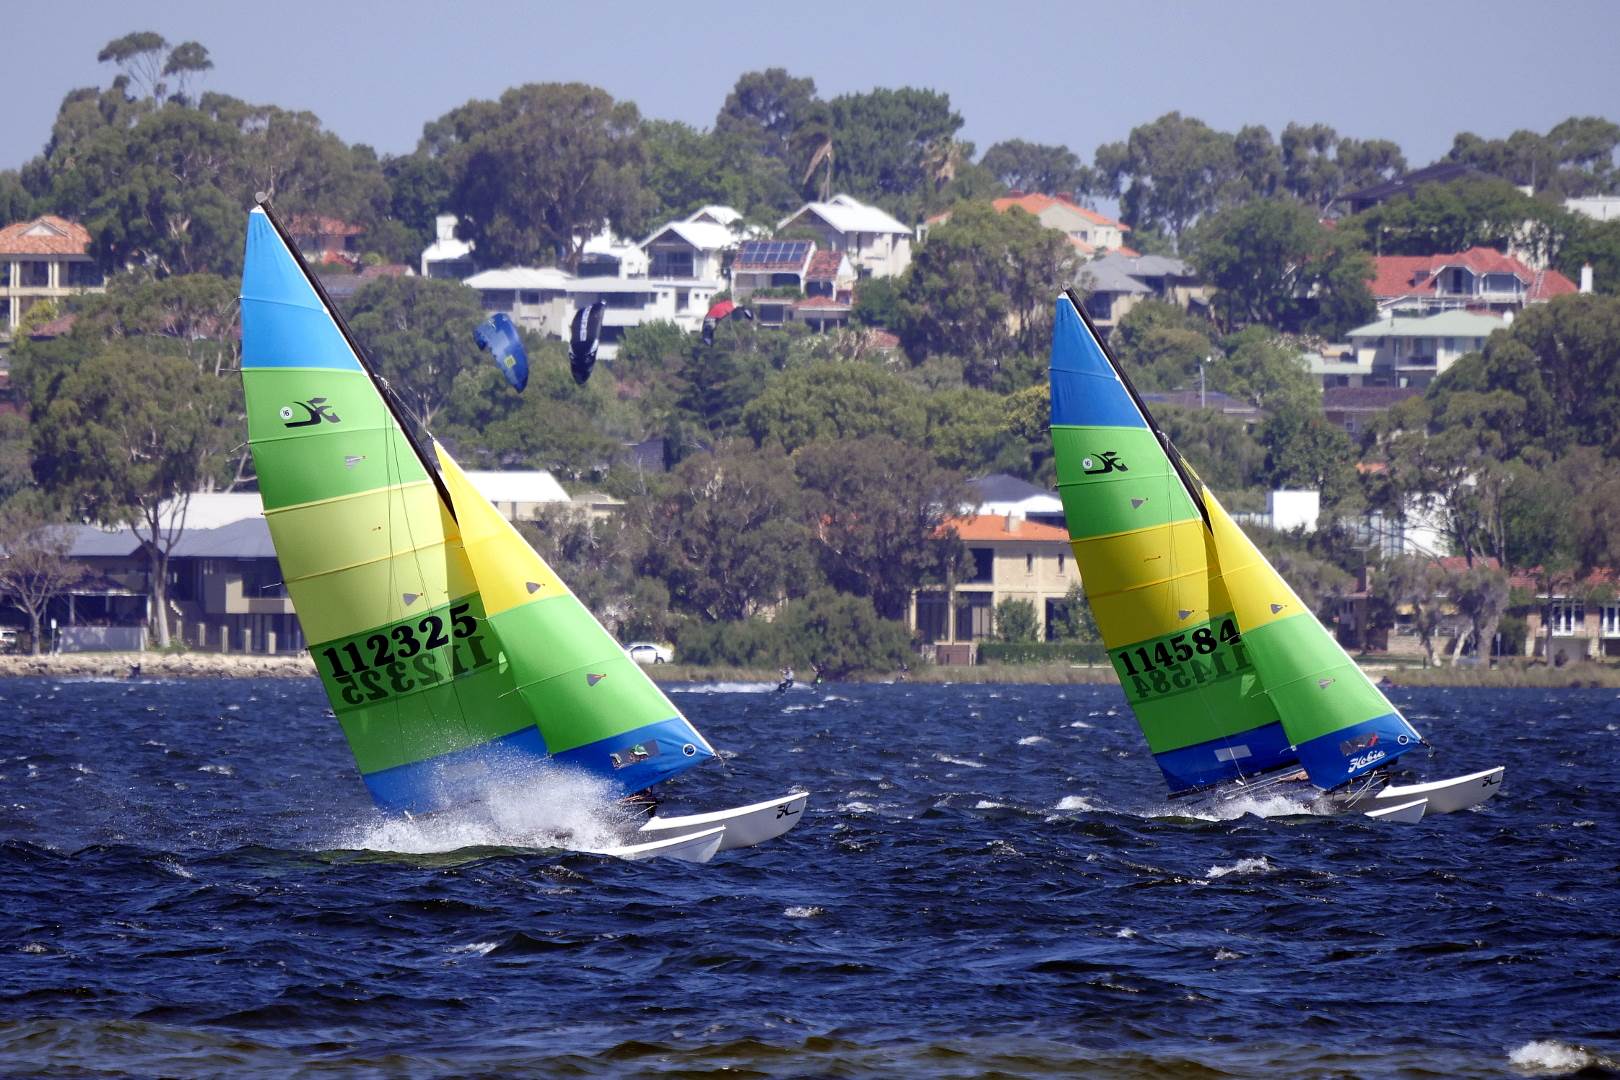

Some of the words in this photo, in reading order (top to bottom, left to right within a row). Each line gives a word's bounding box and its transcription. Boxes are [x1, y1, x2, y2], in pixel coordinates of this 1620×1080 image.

[323, 603, 477, 678] 112325
[1118, 618, 1242, 676] 114584
[1348, 750, 1385, 773] Hobie
